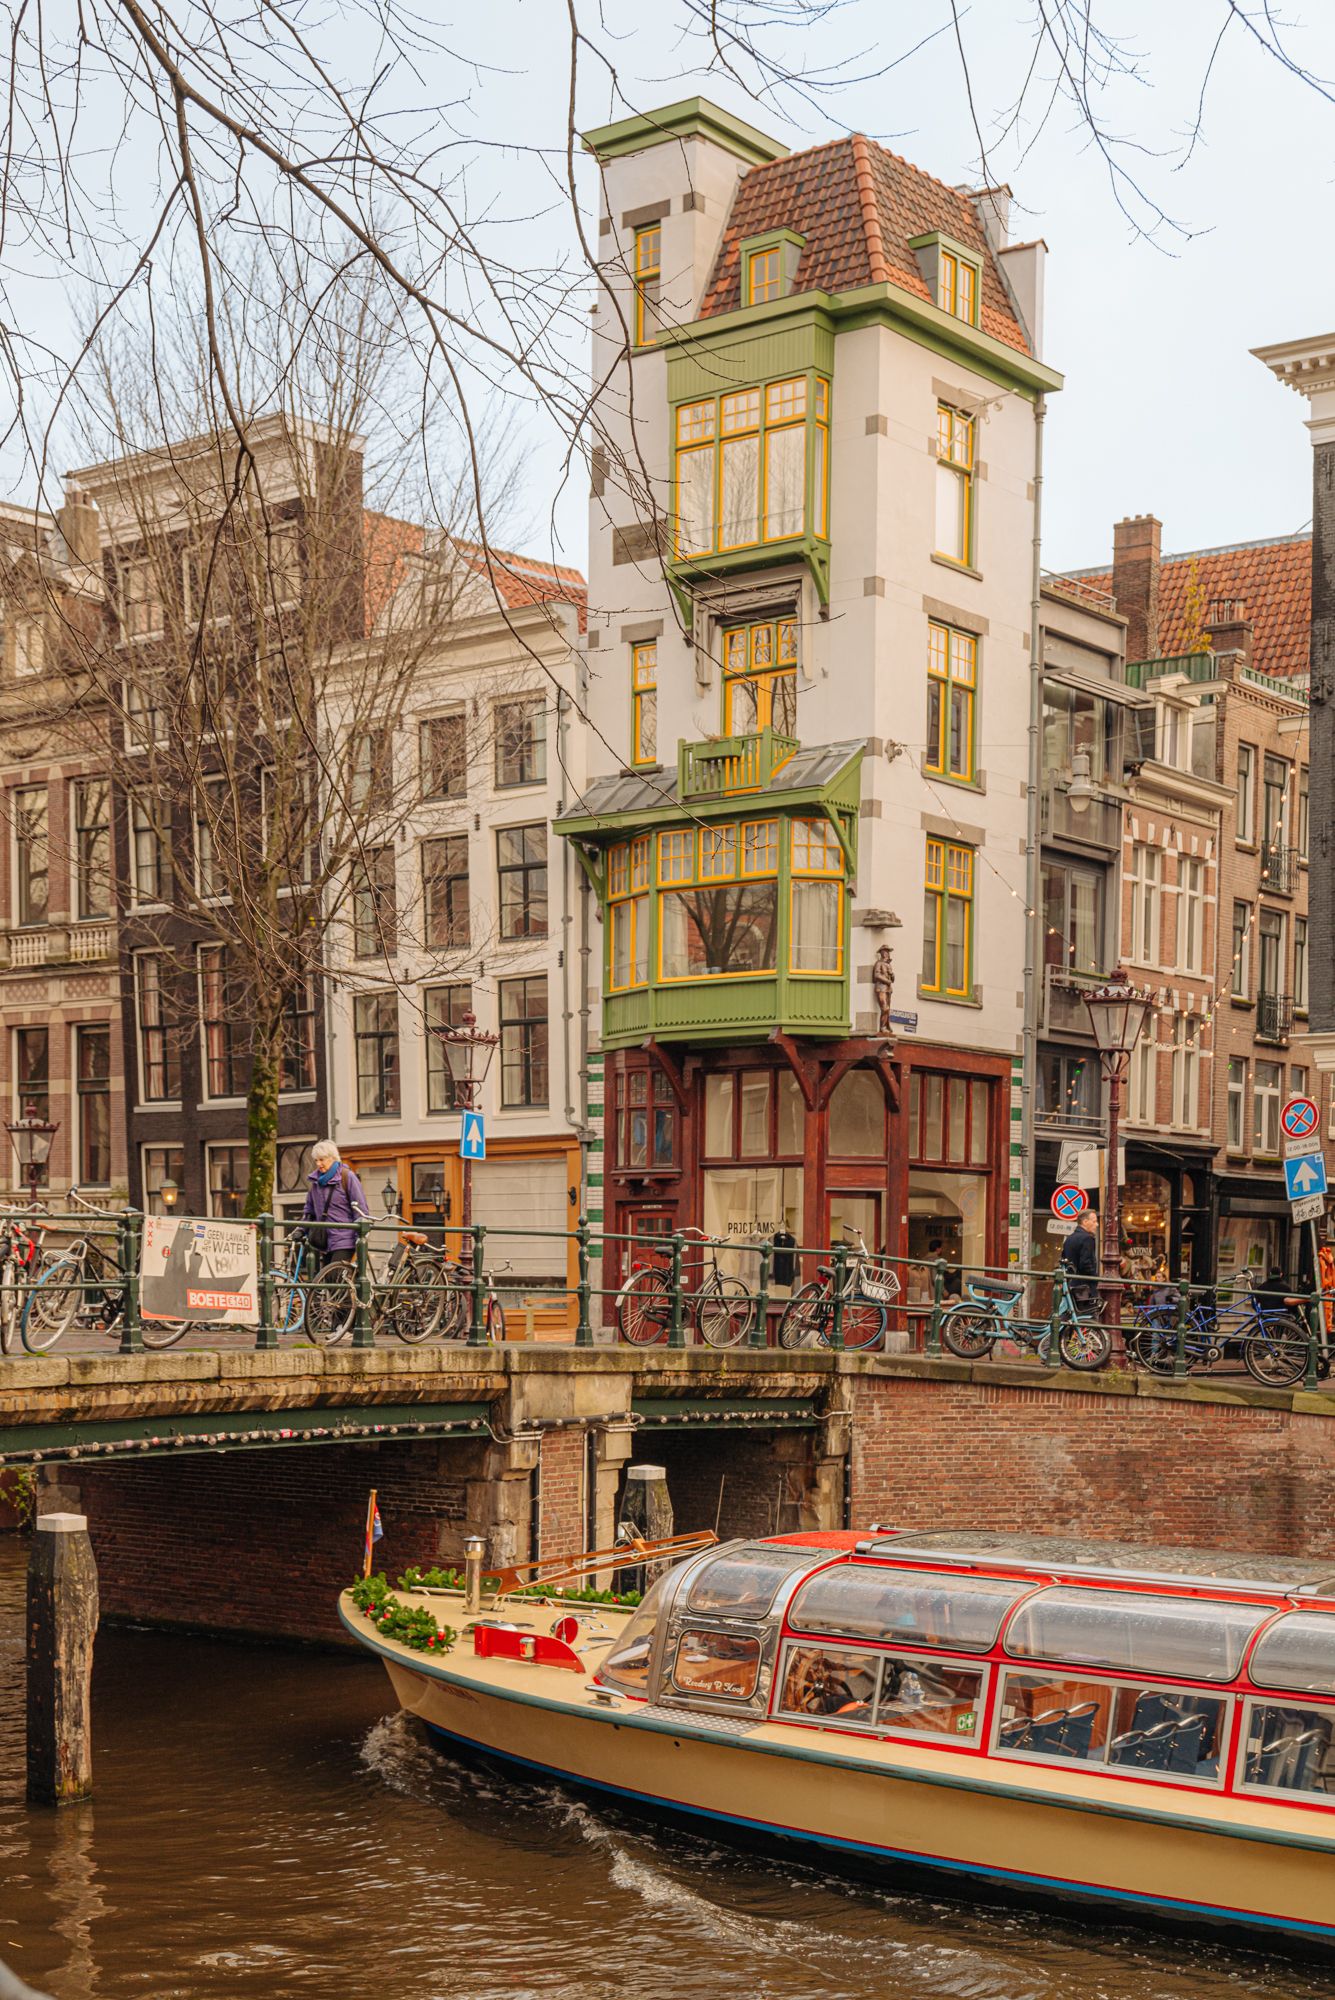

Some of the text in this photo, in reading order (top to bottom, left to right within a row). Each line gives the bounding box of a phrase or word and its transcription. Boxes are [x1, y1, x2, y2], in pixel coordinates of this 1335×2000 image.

[727, 1222, 775, 1234] PRJCT AMS
[206, 1229, 224, 1241] GEEN
[202, 1241, 251, 1257] HET WATER
[189, 1292, 226, 1307] BOETE
